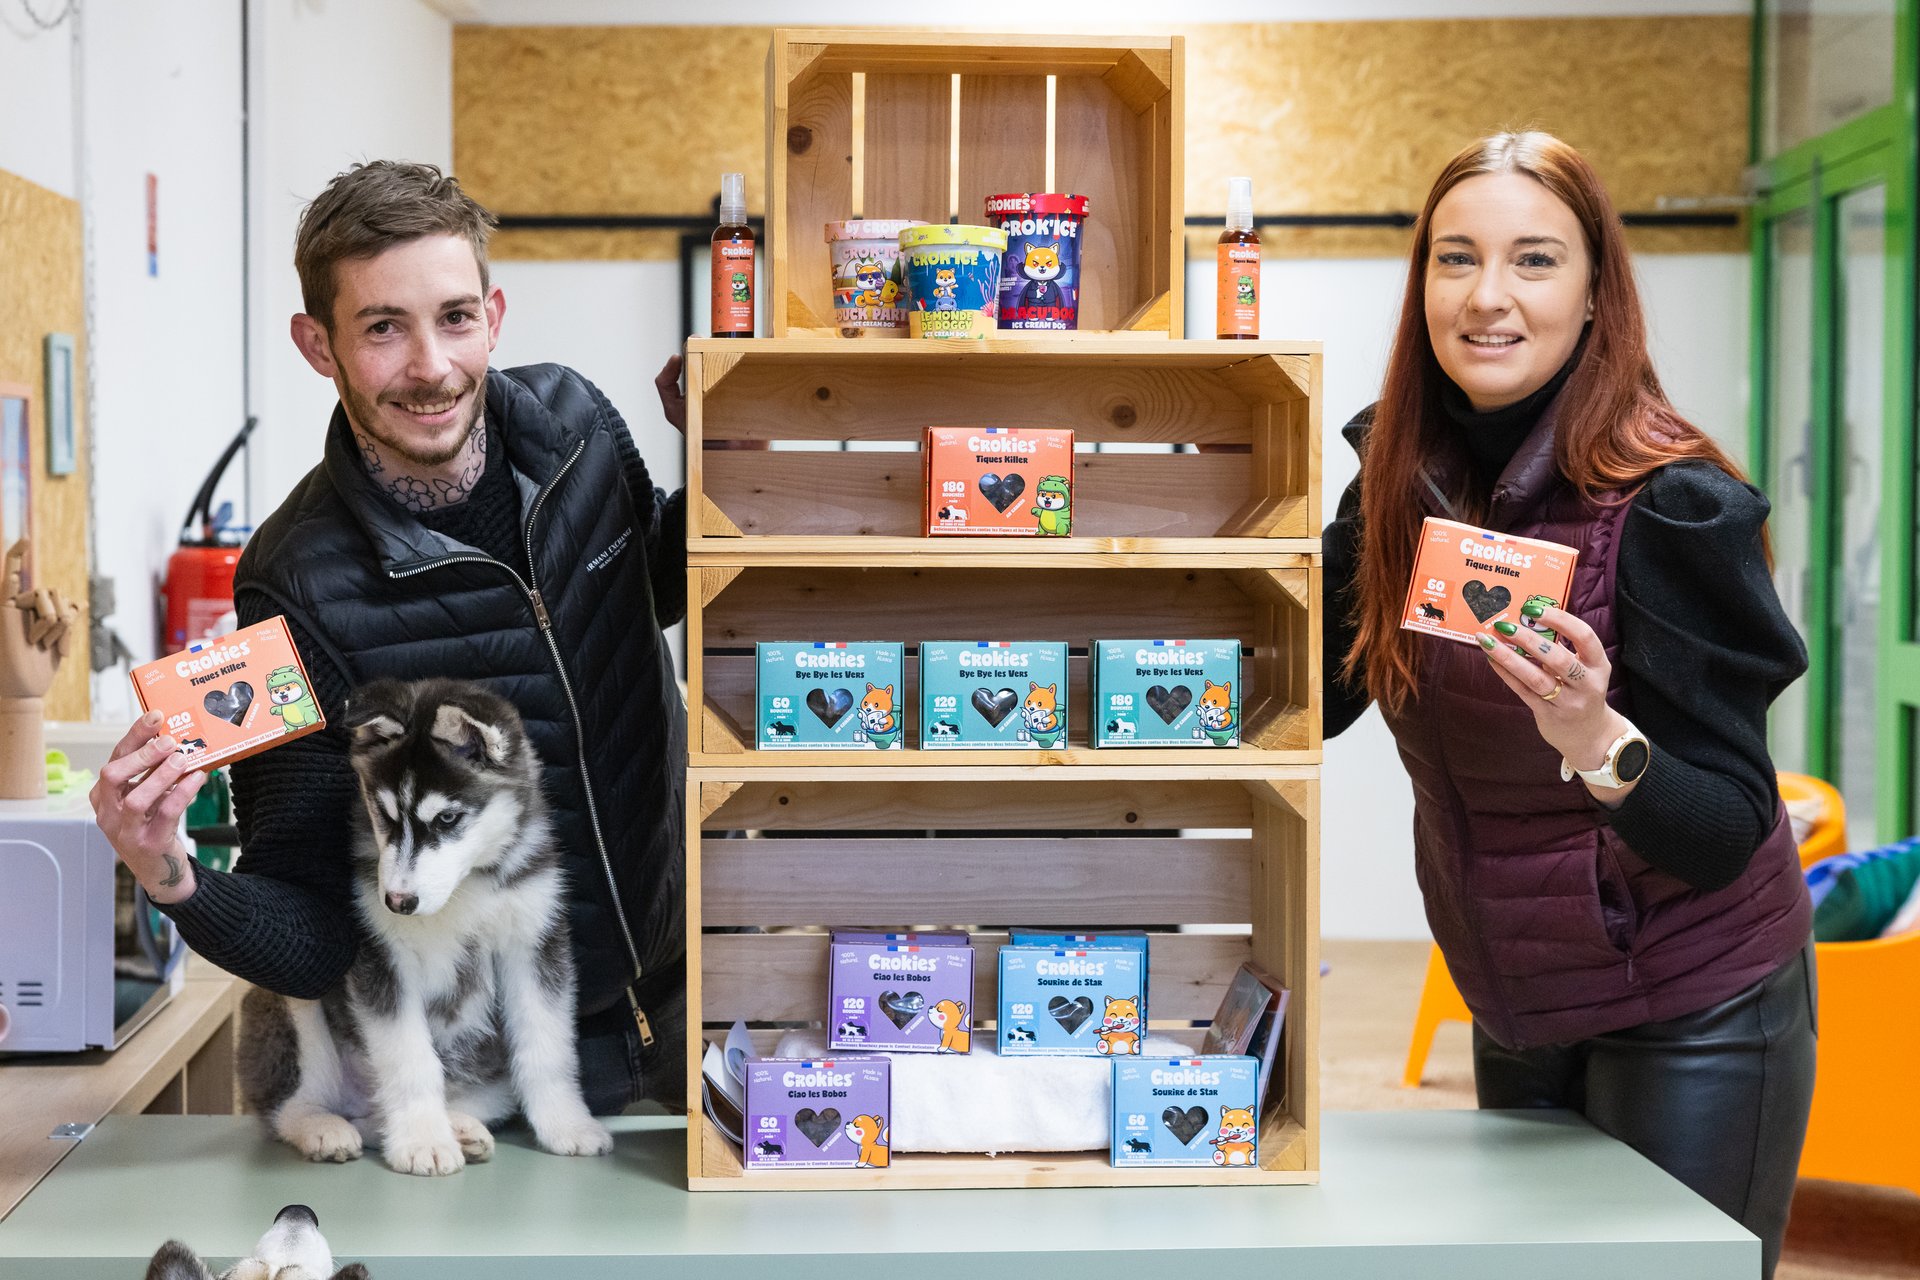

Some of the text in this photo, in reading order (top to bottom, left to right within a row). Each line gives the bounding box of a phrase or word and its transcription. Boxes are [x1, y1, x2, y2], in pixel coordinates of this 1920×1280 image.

[988, 198, 1031, 211] CROKIES
[845, 221, 860, 236] by
[1001, 219, 1076, 238] CROK'ICE
[872, 308, 908, 322] PART
[921, 311, 973, 321] LE MONDE
[1001, 306, 1075, 321] DRACU'DOG
[921, 320, 973, 331] DE DOGGY
[1012, 321, 1066, 330] ICE CREAM DOG
[968, 436, 1036, 453] Crokies
[976, 455, 1028, 464] Tiques Killer
[942, 481, 965, 492] 180
[1459, 538, 1533, 569] Crokies
[1465, 558, 1520, 578] Tiques Killer
[1427, 578, 1445, 592] 60
[175, 641, 250, 678] Crokies
[795, 651, 865, 668] Crokies
[959, 650, 1029, 667] Crokies
[1135, 649, 1204, 666] Crokies
[190, 661, 247, 687] Tiques Killer
[796, 670, 865, 679] Bye Bye les Vers
[959, 670, 1028, 679] Bye Bye les Vers
[1136, 668, 1203, 677] Bye Bye les Vers
[772, 697, 790, 708] 60
[934, 696, 957, 707] 120
[1110, 694, 1133, 706] 180
[167, 711, 191, 729] 120
[868, 954, 937, 972] Crokies
[1036, 959, 1104, 976] Crokies
[873, 973, 931, 982] Ciao les Bobos
[1038, 978, 1102, 986] Sourire de Star
[842, 998, 865, 1009] 120
[1011, 1003, 1033, 1015] 120
[783, 1071, 852, 1088] Crokies
[1151, 1069, 1220, 1086] Crokies
[788, 1090, 847, 1098] Ciao les Bobos
[1152, 1088, 1218, 1096] Sourire de Star
[760, 1117, 778, 1128] 60
[1128, 1115, 1146, 1126] 60
